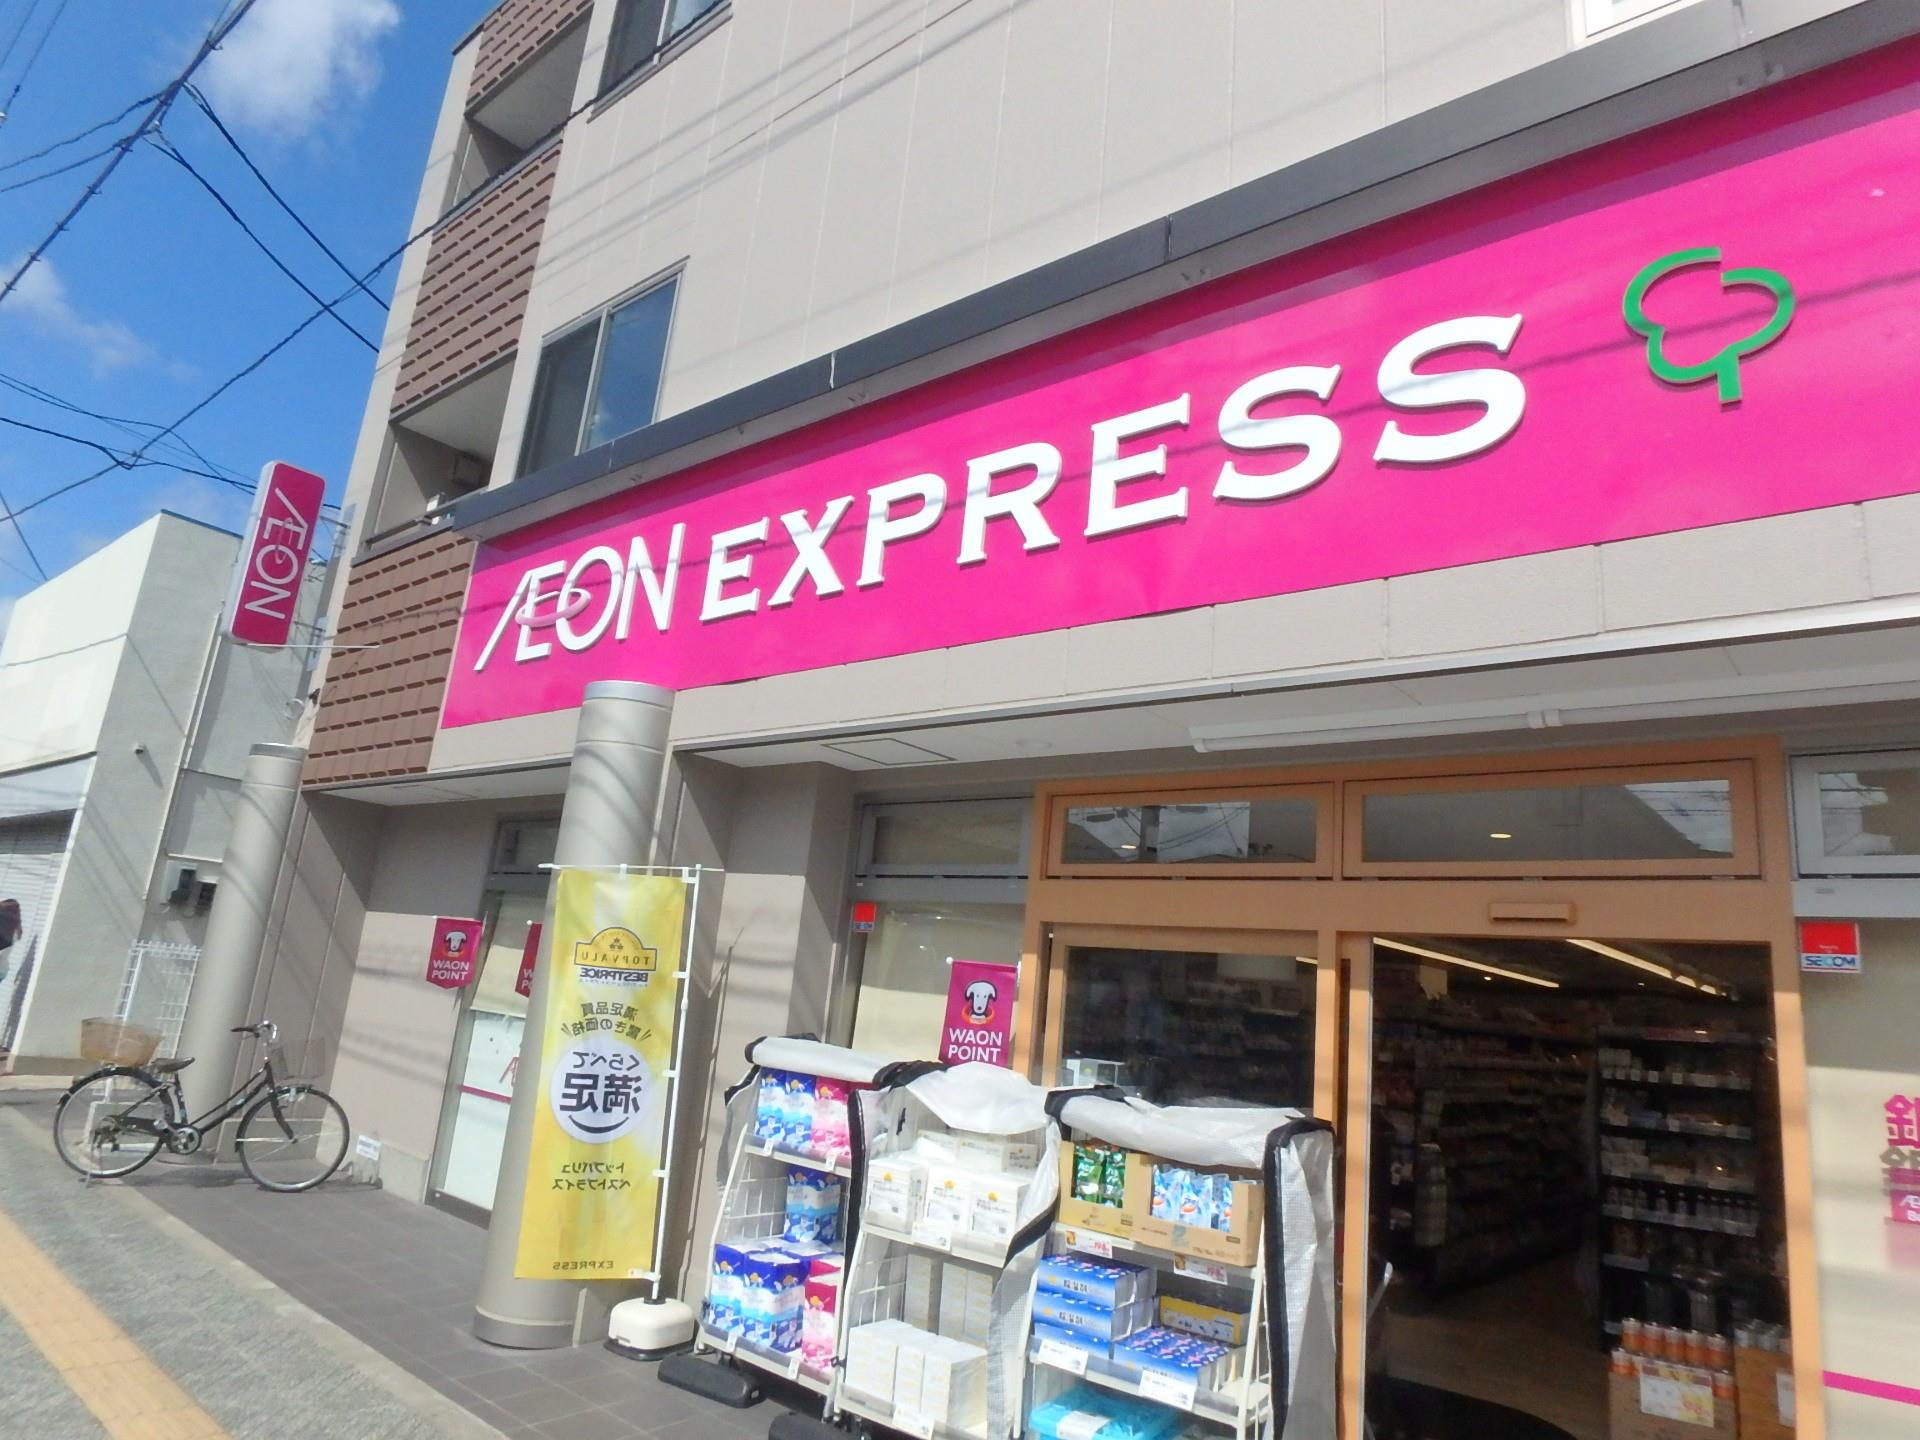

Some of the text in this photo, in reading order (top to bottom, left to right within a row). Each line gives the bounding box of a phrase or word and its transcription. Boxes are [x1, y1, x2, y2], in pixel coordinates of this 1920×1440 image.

[699, 313, 1528, 623] EXPRESS
[433, 959, 470, 971] WAON
[1805, 955, 1856, 967] SECOM
[431, 969, 469, 981] POINT
[949, 1027, 1003, 1047] WAON
[947, 1044, 1001, 1063] POINT
